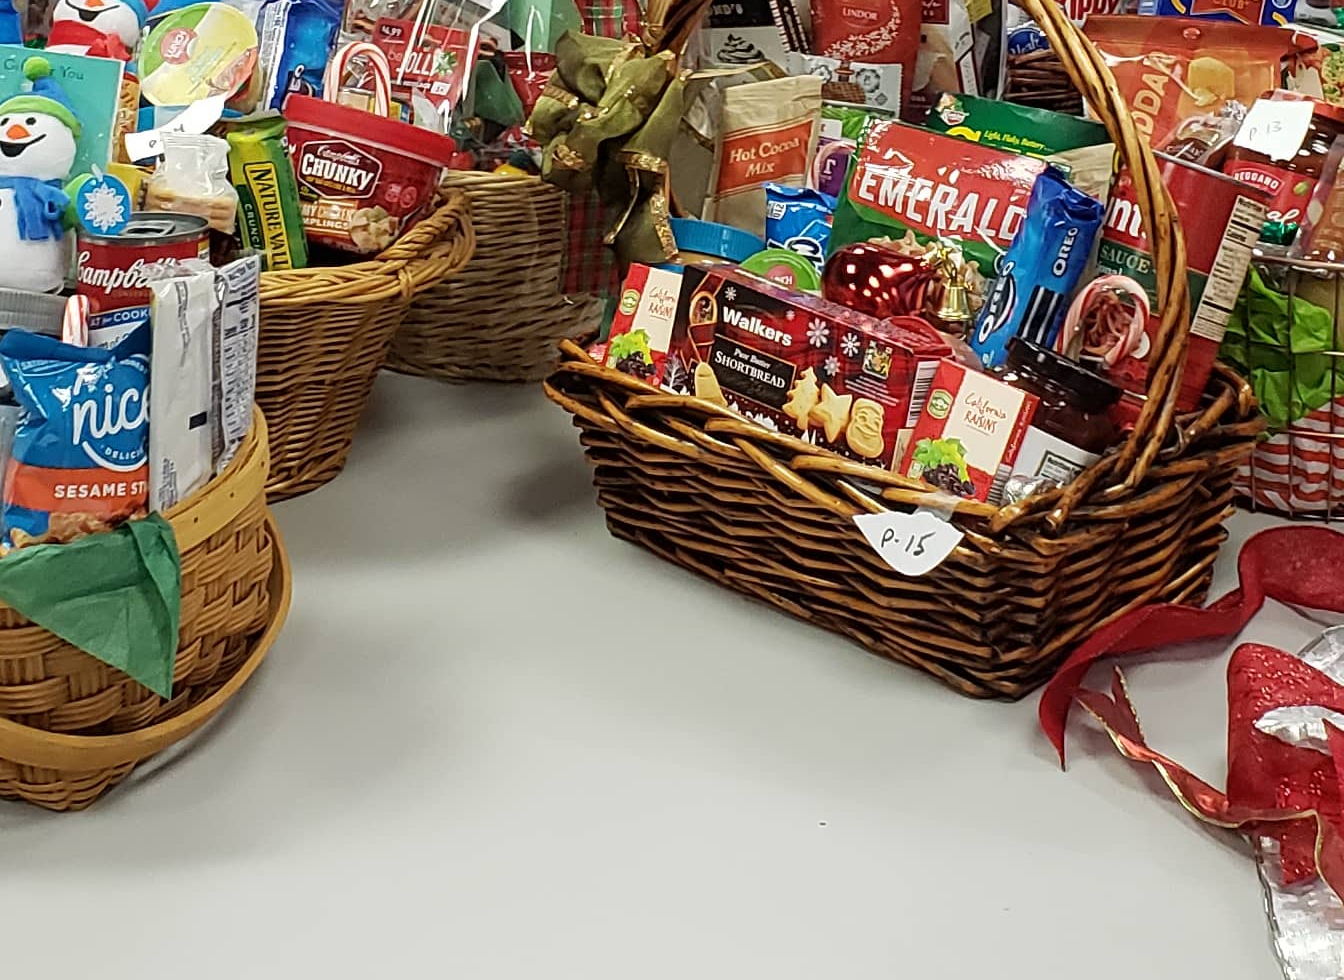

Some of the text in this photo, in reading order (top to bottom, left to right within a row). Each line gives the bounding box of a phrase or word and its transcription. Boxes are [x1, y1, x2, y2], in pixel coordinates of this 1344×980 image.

[842, 7, 879, 21] LINDOR
[61, 65, 85, 81] You
[729, 136, 802, 164] Hot Cocoa
[300, 152, 375, 191] CHUNKY
[744, 160, 776, 178] Mix
[250, 169, 292, 270] NATURE VALL
[858, 167, 1028, 242] EMERALD
[1052, 226, 1080, 276] OREO
[1100, 243, 1154, 275] SAUCE
[722, 305, 793, 349] Walkers
[714, 350, 787, 390] SHORTBREAD
[964, 392, 1009, 420] California
[54, 482, 127, 499] SESAME
